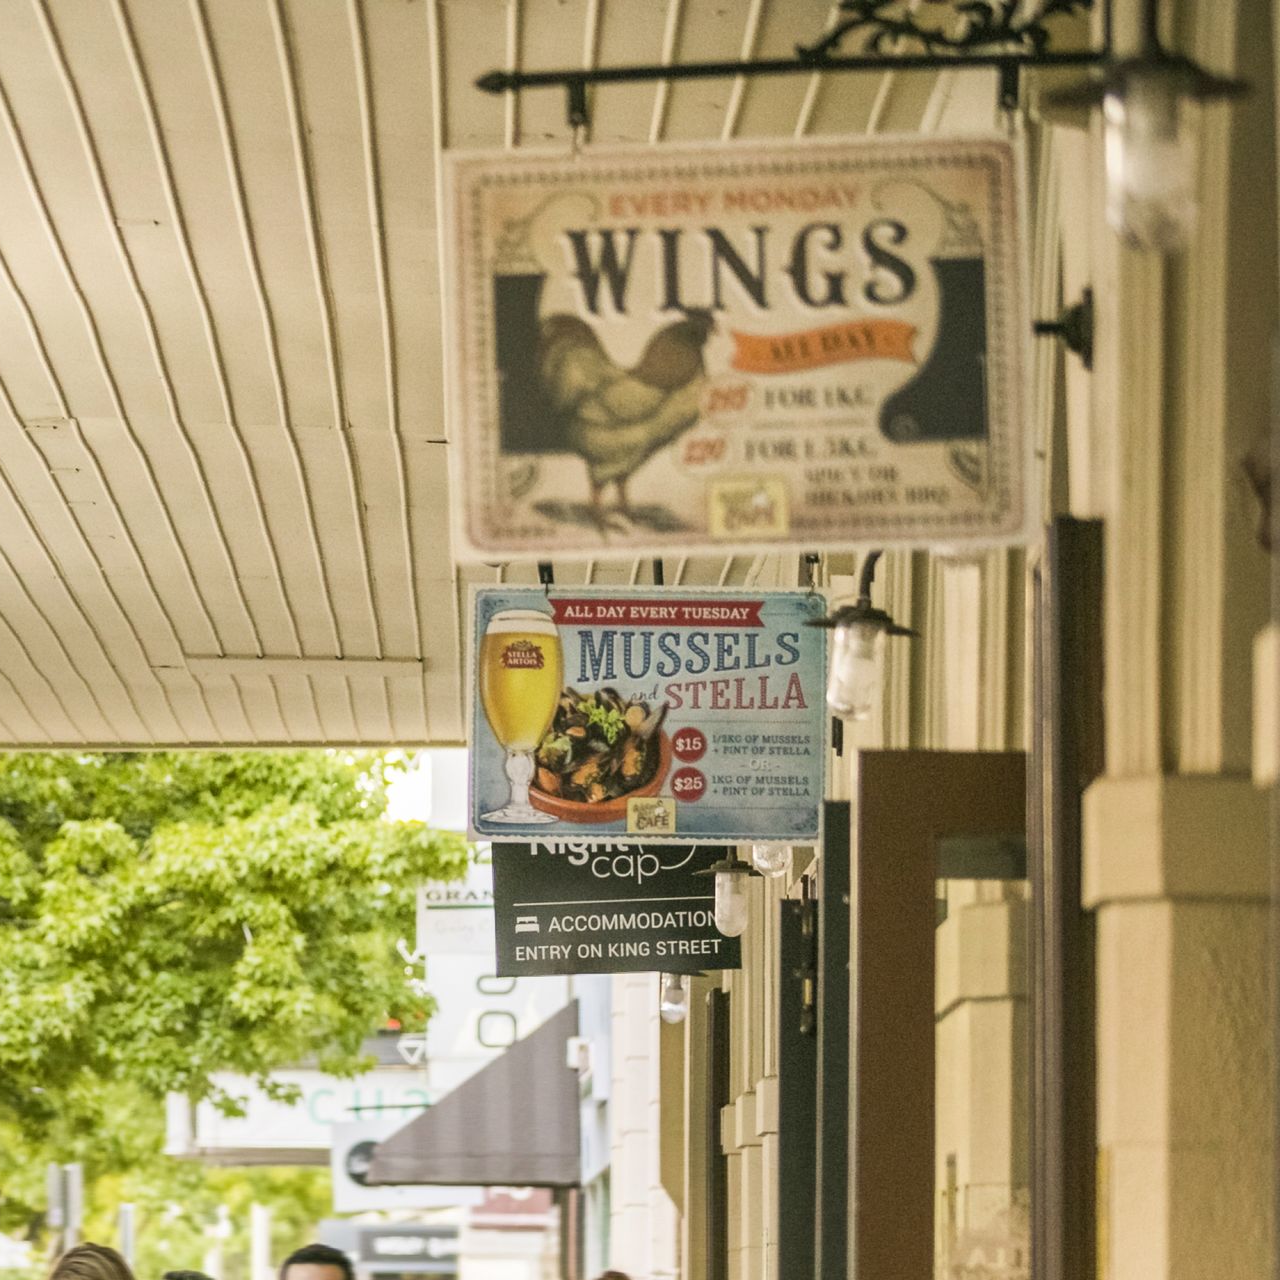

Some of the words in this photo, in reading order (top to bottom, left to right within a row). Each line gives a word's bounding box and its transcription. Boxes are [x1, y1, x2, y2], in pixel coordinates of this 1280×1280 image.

[609, 192, 709, 217] EVERY
[723, 187, 858, 213] MONDAY
[563, 217, 919, 316] WINGS
[765, 386, 817, 408] FOR
[744, 439, 797, 462] FOR
[564, 605, 593, 618] ALL
[597, 606, 626, 619] DAY
[630, 606, 679, 619] EVERY
[682, 607, 751, 620] TUESDAY
[576, 629, 801, 683] MUSSELS
[630, 684, 659, 702] and
[664, 671, 810, 710] STELLA
[675, 736, 702, 752] $15
[745, 735, 760, 744] OF
[762, 734, 810, 745] MUSSELS
[723, 746, 748, 755] PINT
[751, 746, 764, 755] OF
[768, 746, 811, 756] STELLA
[750, 760, 772, 772] OR
[673, 776, 703, 792] $25
[736, 775, 750, 785] OF
[755, 775, 810, 785] MUSSELS
[722, 787, 748, 796] PINT
[751, 787, 764, 796] OF
[768, 787, 811, 797] STELLA
[591, 854, 659, 885] cap
[548, 910, 717, 932] ACCOMMODATION
[515, 944, 573, 961] ENTRY
[578, 943, 602, 958] ON
[608, 941, 650, 957] KING
[656, 938, 722, 955] STREET
